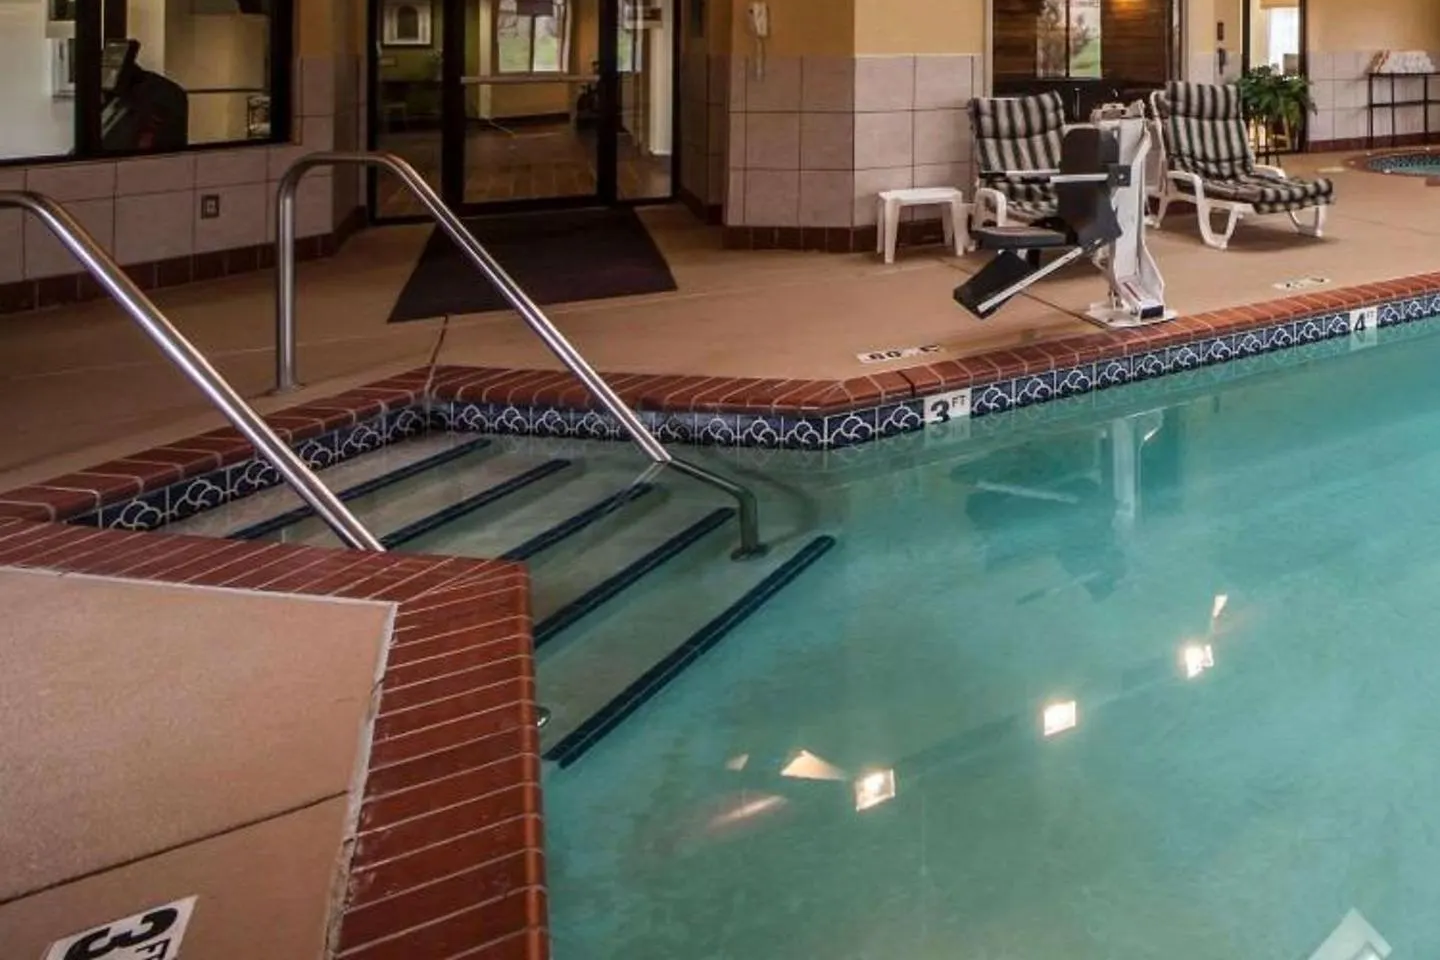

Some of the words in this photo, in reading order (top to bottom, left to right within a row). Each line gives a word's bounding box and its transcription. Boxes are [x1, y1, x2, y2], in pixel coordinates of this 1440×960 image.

[1354, 312, 1366, 331] 4
[929, 399, 951, 424] 3
[951, 394, 967, 408] FT
[63, 907, 179, 960] 3
